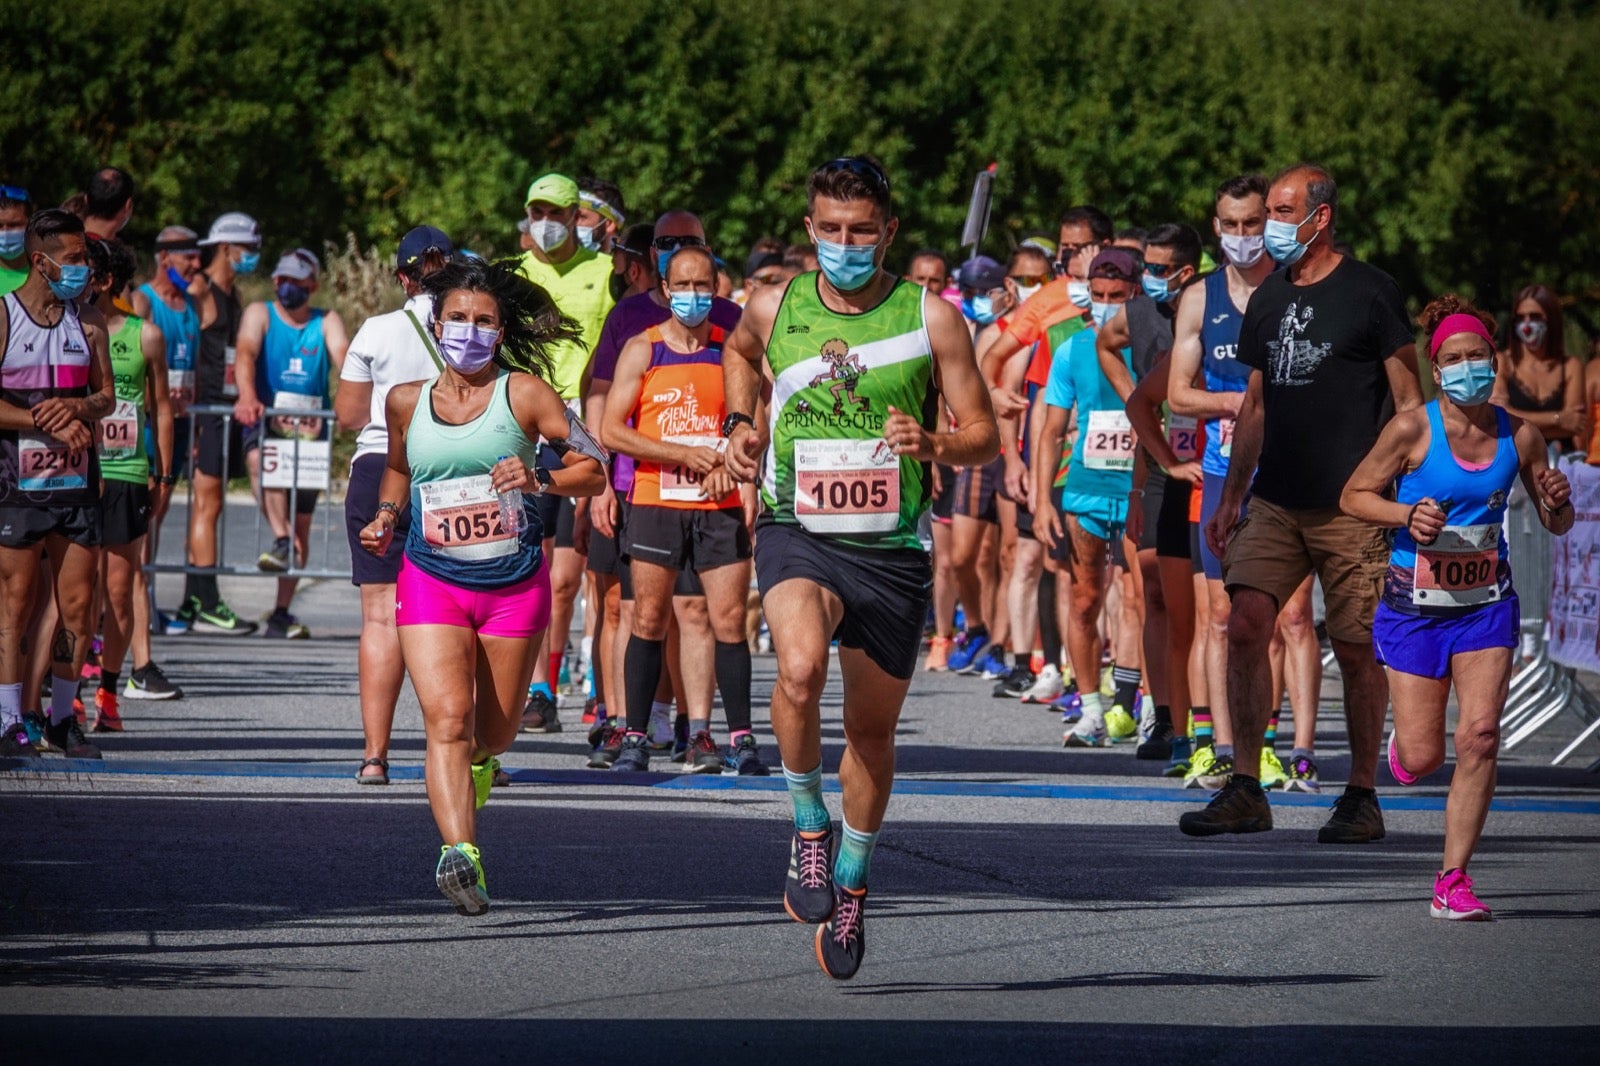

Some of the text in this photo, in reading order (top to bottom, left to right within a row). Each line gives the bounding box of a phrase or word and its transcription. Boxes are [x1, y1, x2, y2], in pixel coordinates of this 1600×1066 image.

[784, 409, 883, 430] PRIMEGUIS
[105, 423, 128, 440] 01
[1096, 433, 1132, 451] 215
[32, 450, 82, 470] 2210
[672, 465, 699, 485] 10
[811, 479, 889, 510] 1005
[437, 511, 506, 543] 1052
[1429, 558, 1492, 587] 1080
